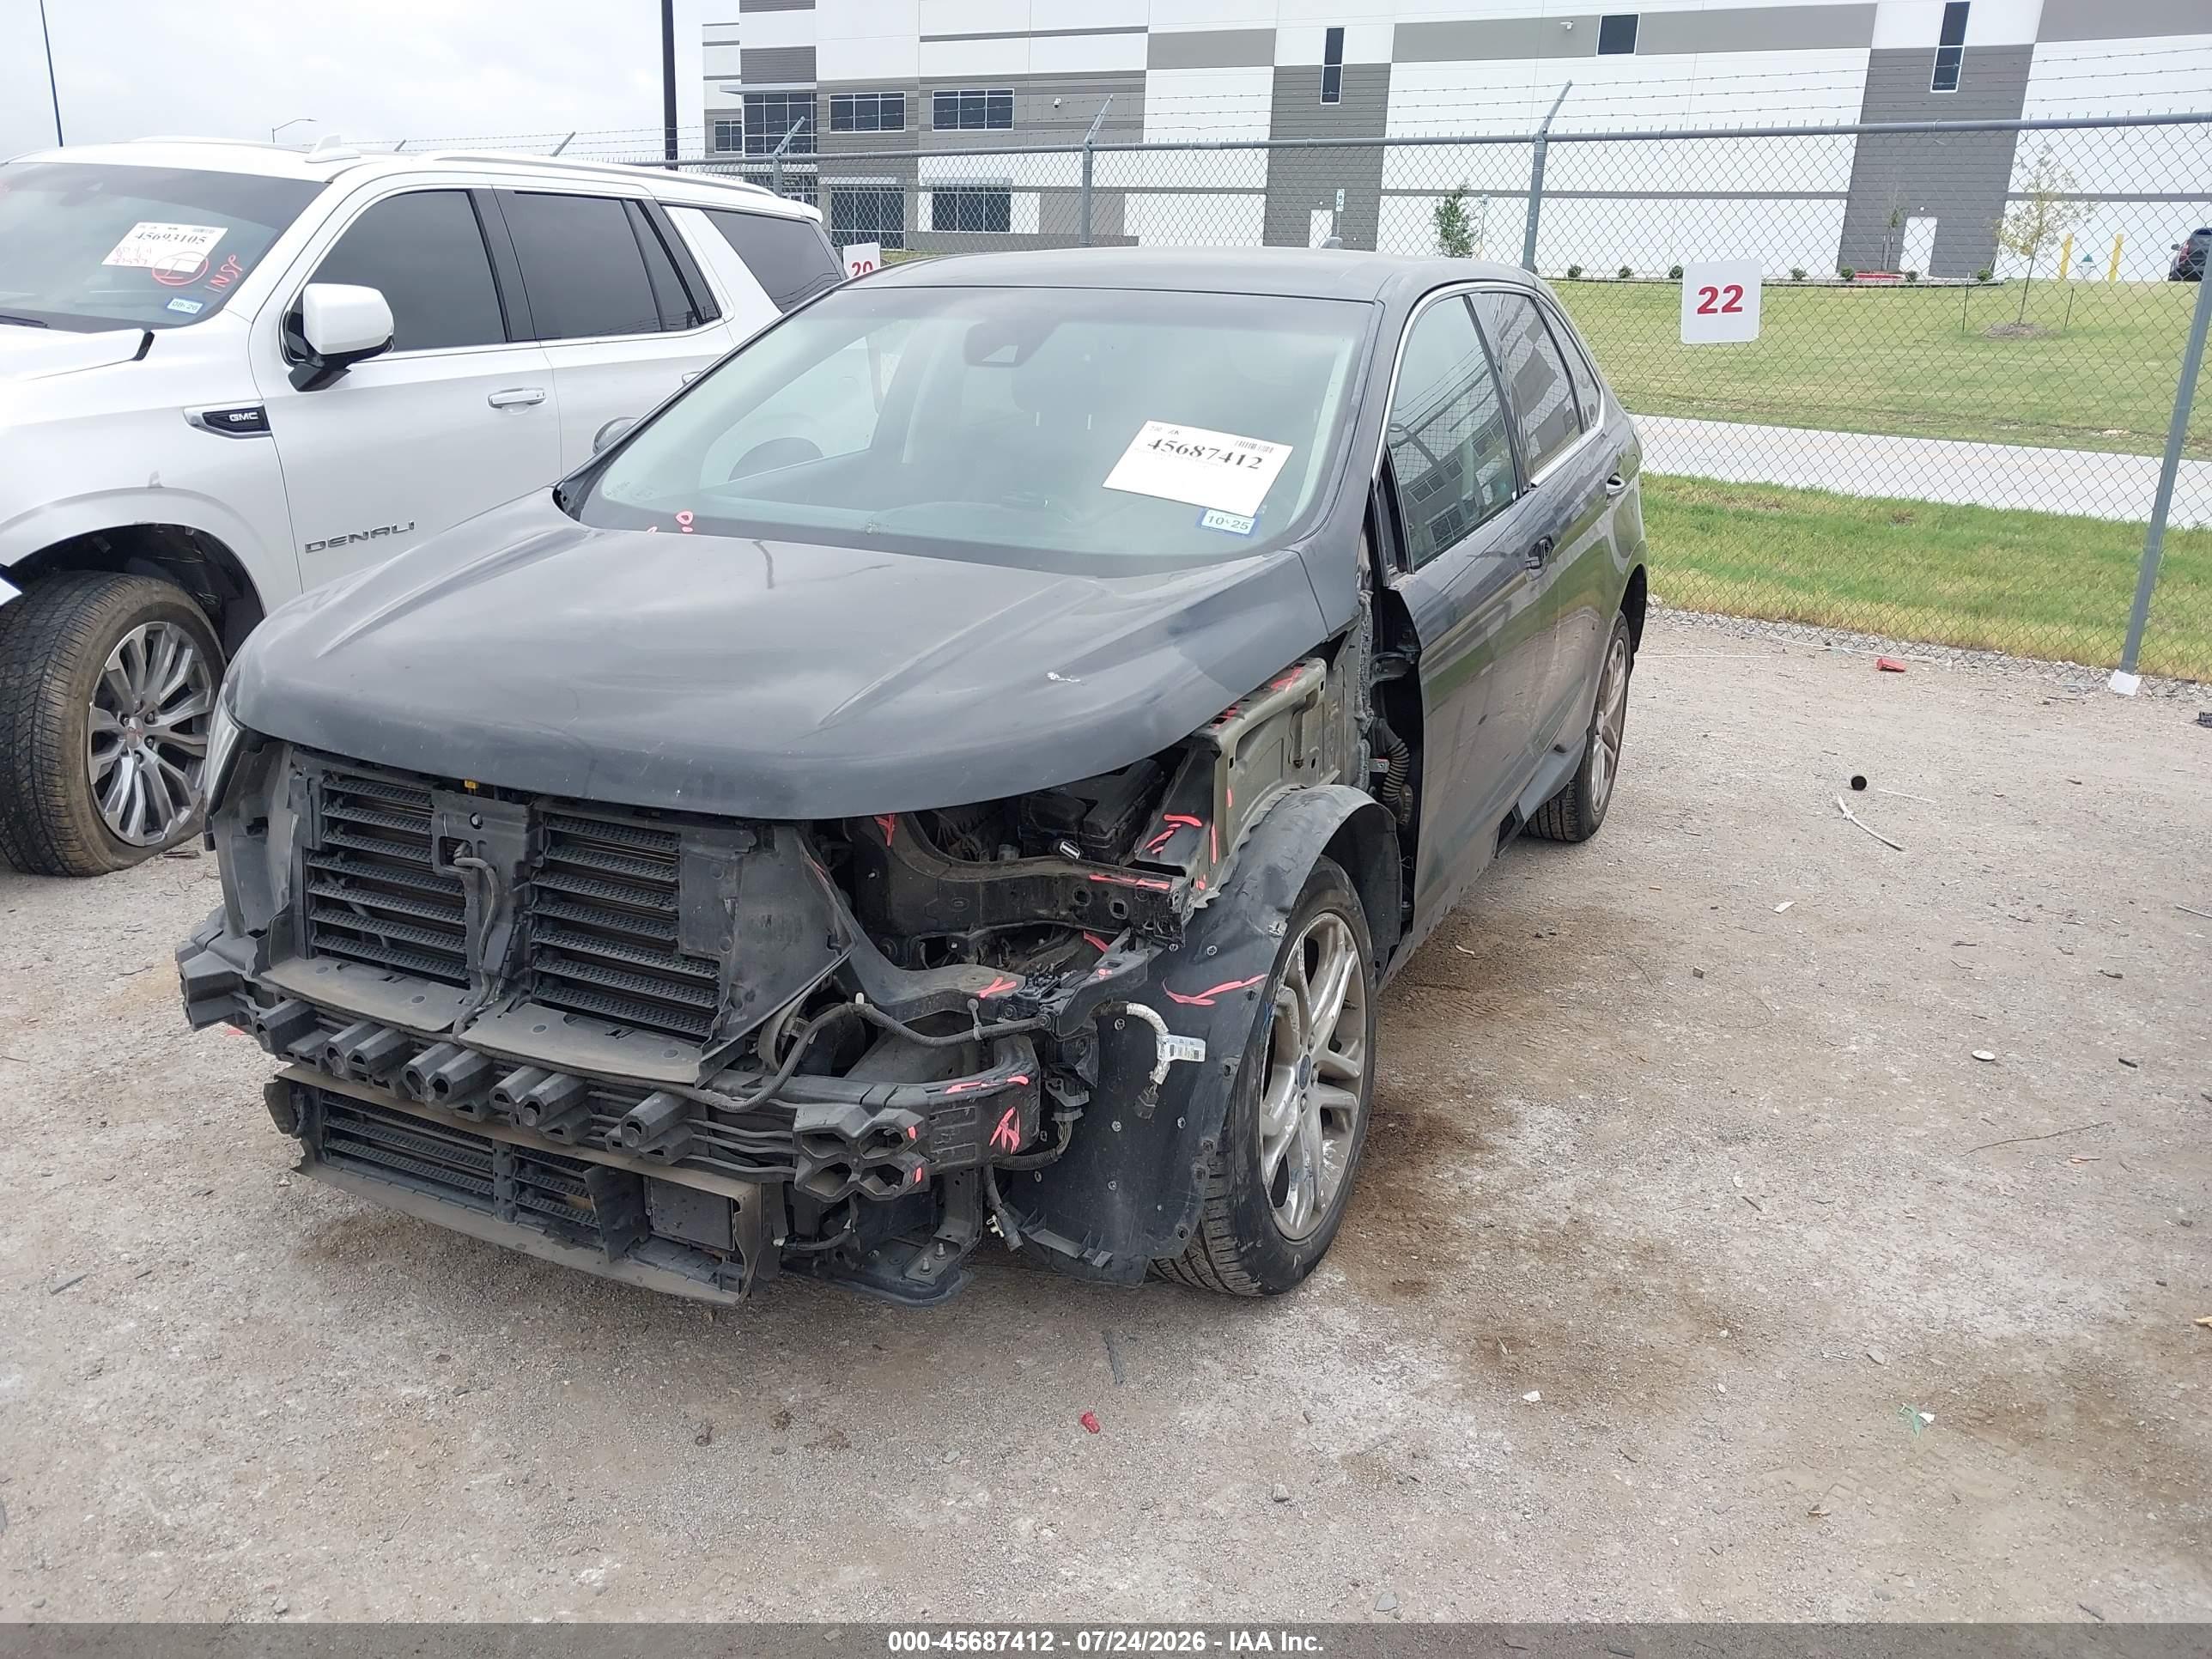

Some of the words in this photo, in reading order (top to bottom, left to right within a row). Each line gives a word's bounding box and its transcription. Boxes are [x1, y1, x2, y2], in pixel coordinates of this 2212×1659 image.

[135, 231, 207, 245] 45693105
[1697, 284, 1744, 315] 22
[228, 412, 259, 422] GMC
[1146, 438, 1263, 470] 45687412
[304, 520, 415, 554] DENALI
